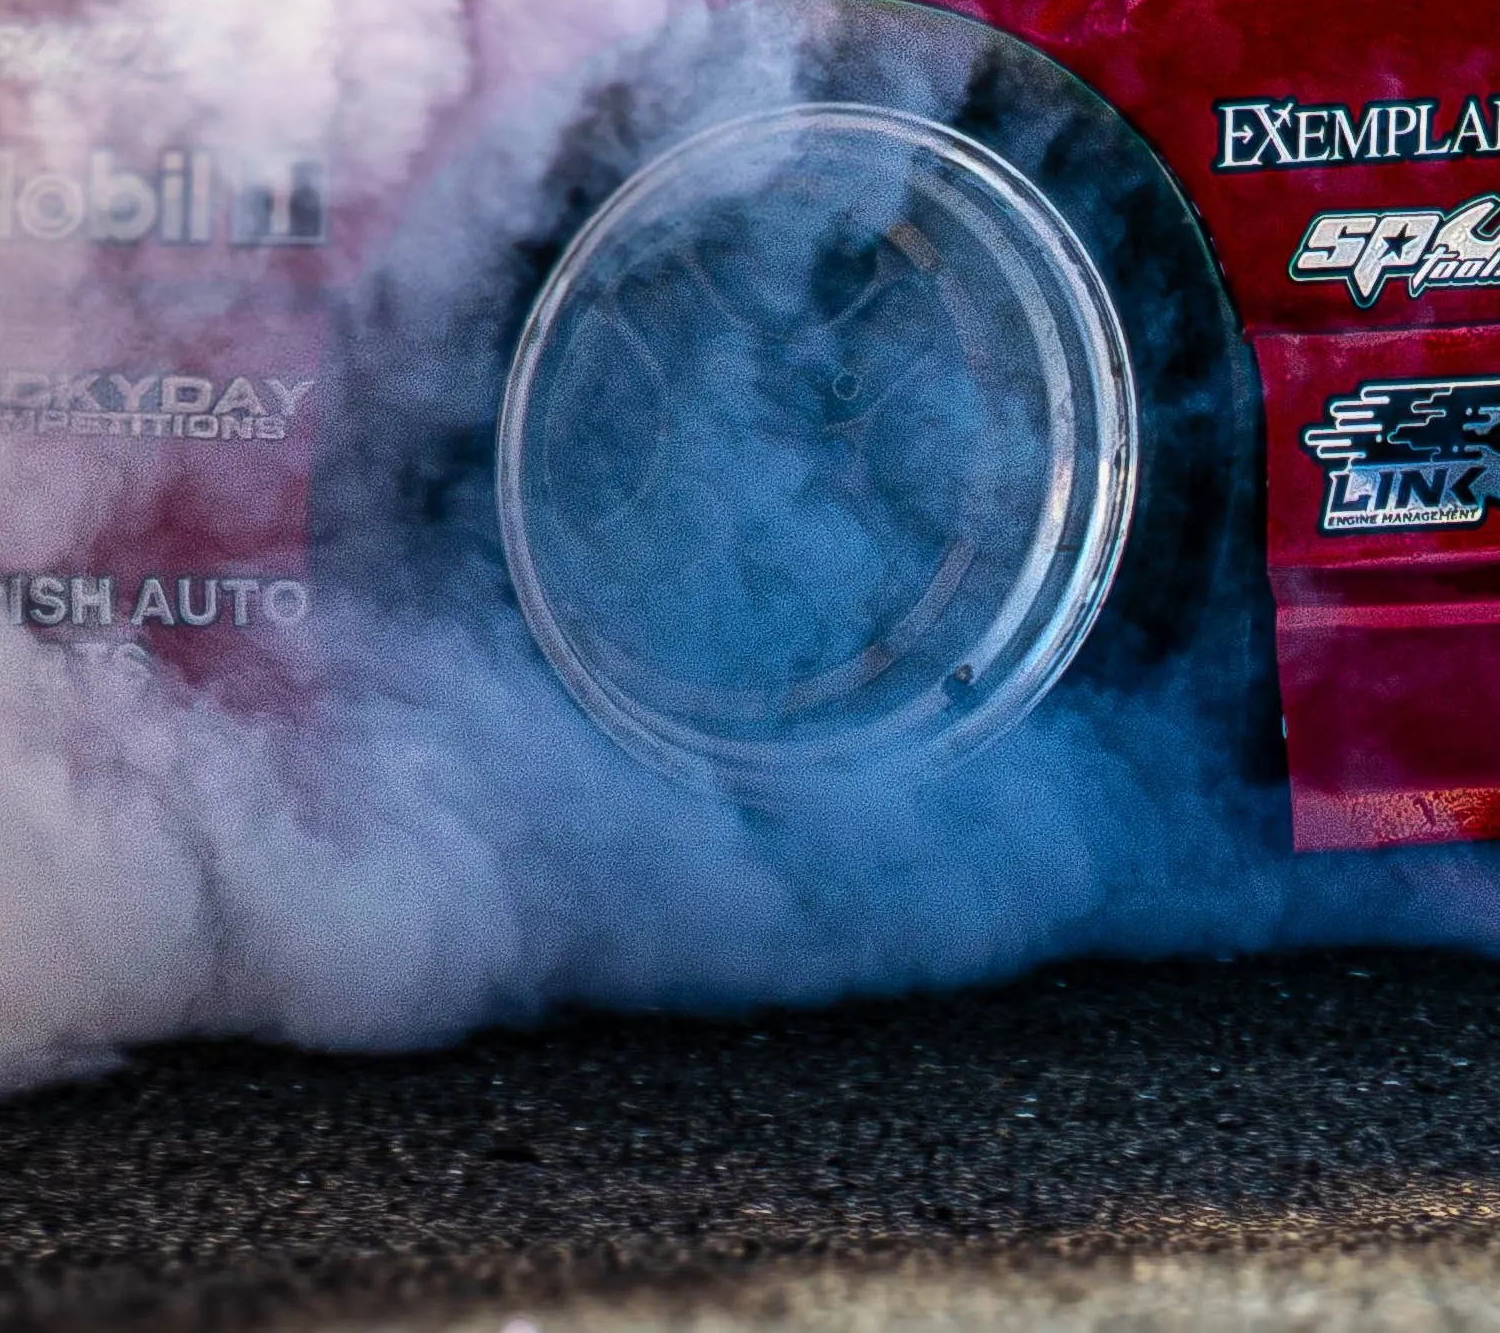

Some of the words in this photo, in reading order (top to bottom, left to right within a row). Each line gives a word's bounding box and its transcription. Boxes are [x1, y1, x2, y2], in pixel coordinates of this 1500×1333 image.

[1329, 466, 1488, 512] LINK
[1327, 514, 1378, 527] ENGINE
[1381, 508, 1480, 525] MANAGEMENT
[129, 576, 310, 630] AUTO
